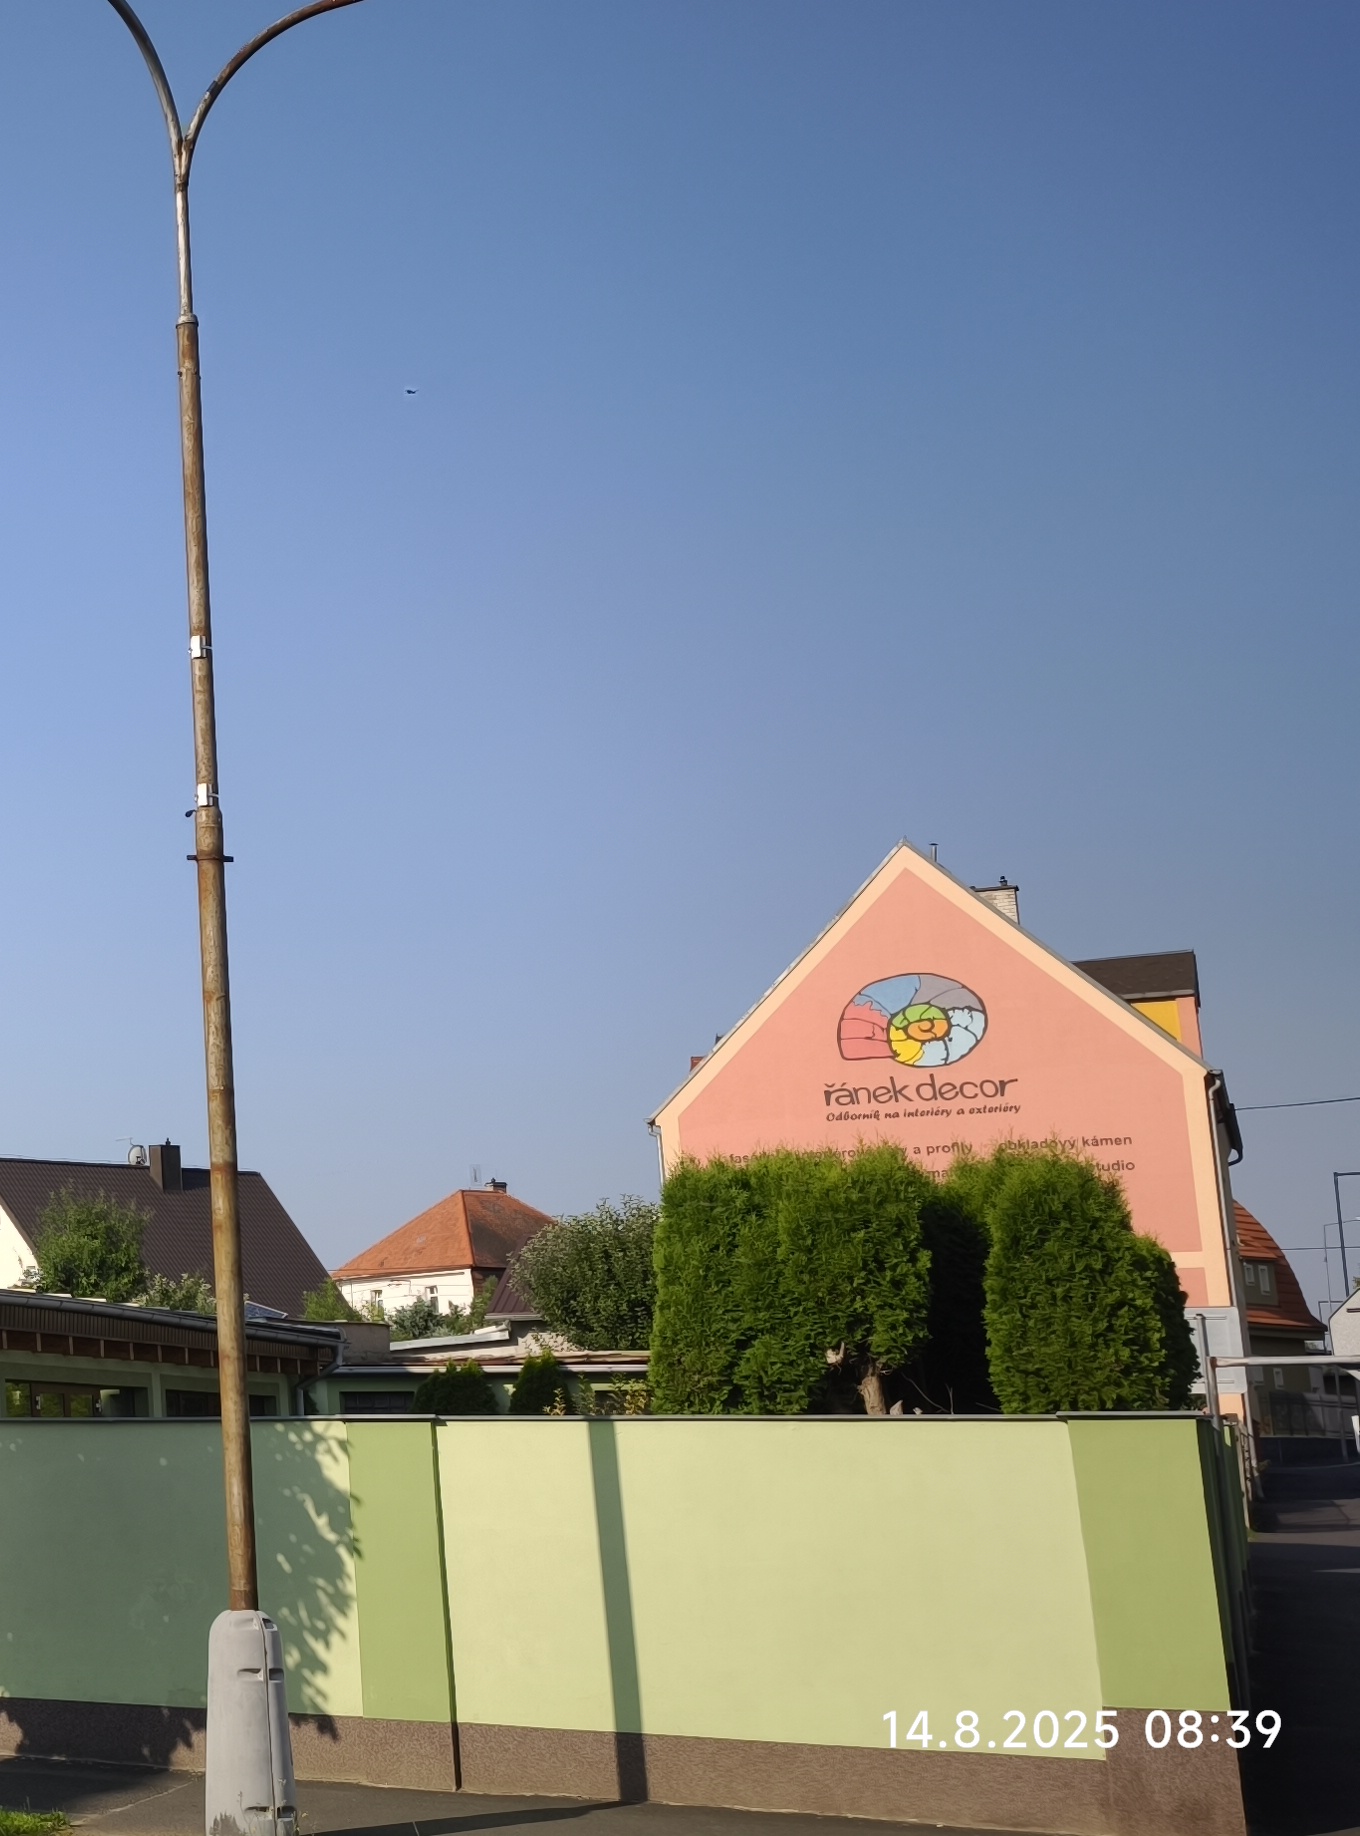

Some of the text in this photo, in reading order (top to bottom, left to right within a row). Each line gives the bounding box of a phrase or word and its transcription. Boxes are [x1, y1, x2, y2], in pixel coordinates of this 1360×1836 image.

[823, 1073, 1018, 1106] řánek decor
[826, 1102, 1021, 1121] Odborník na interiéry a exteriéry
[913, 1146, 922, 1155] a
[1081, 1135, 1133, 1147] kámen
[1093, 1159, 1135, 1172] tudio
